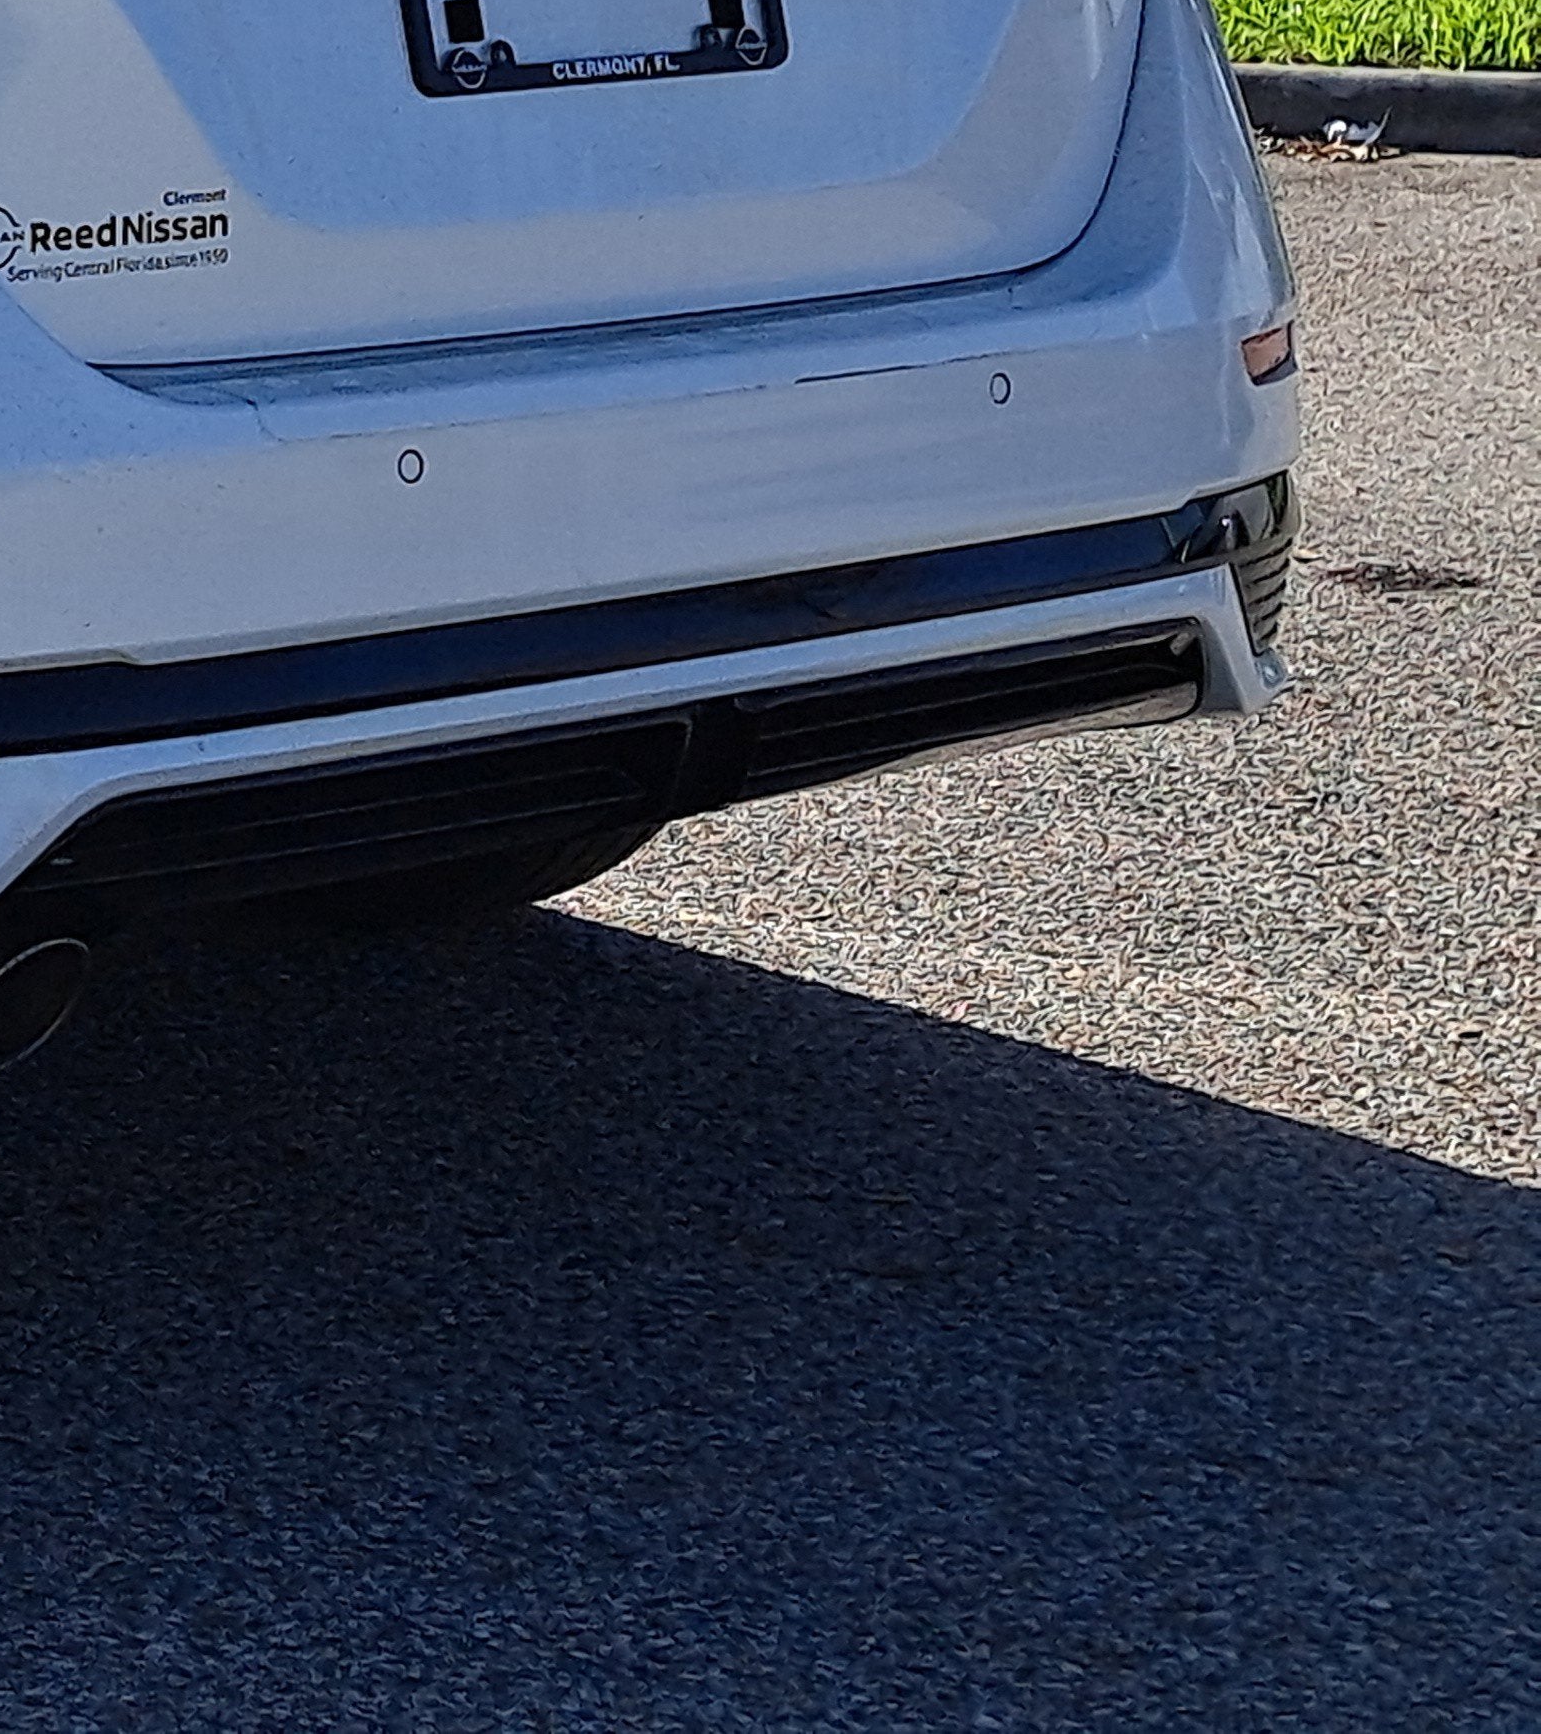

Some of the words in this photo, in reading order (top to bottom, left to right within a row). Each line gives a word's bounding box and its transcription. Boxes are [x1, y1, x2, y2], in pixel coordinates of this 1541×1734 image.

[163, 188, 227, 207] Clermont
[6, 264, 62, 283] Serving
[64, 257, 114, 277] Central
